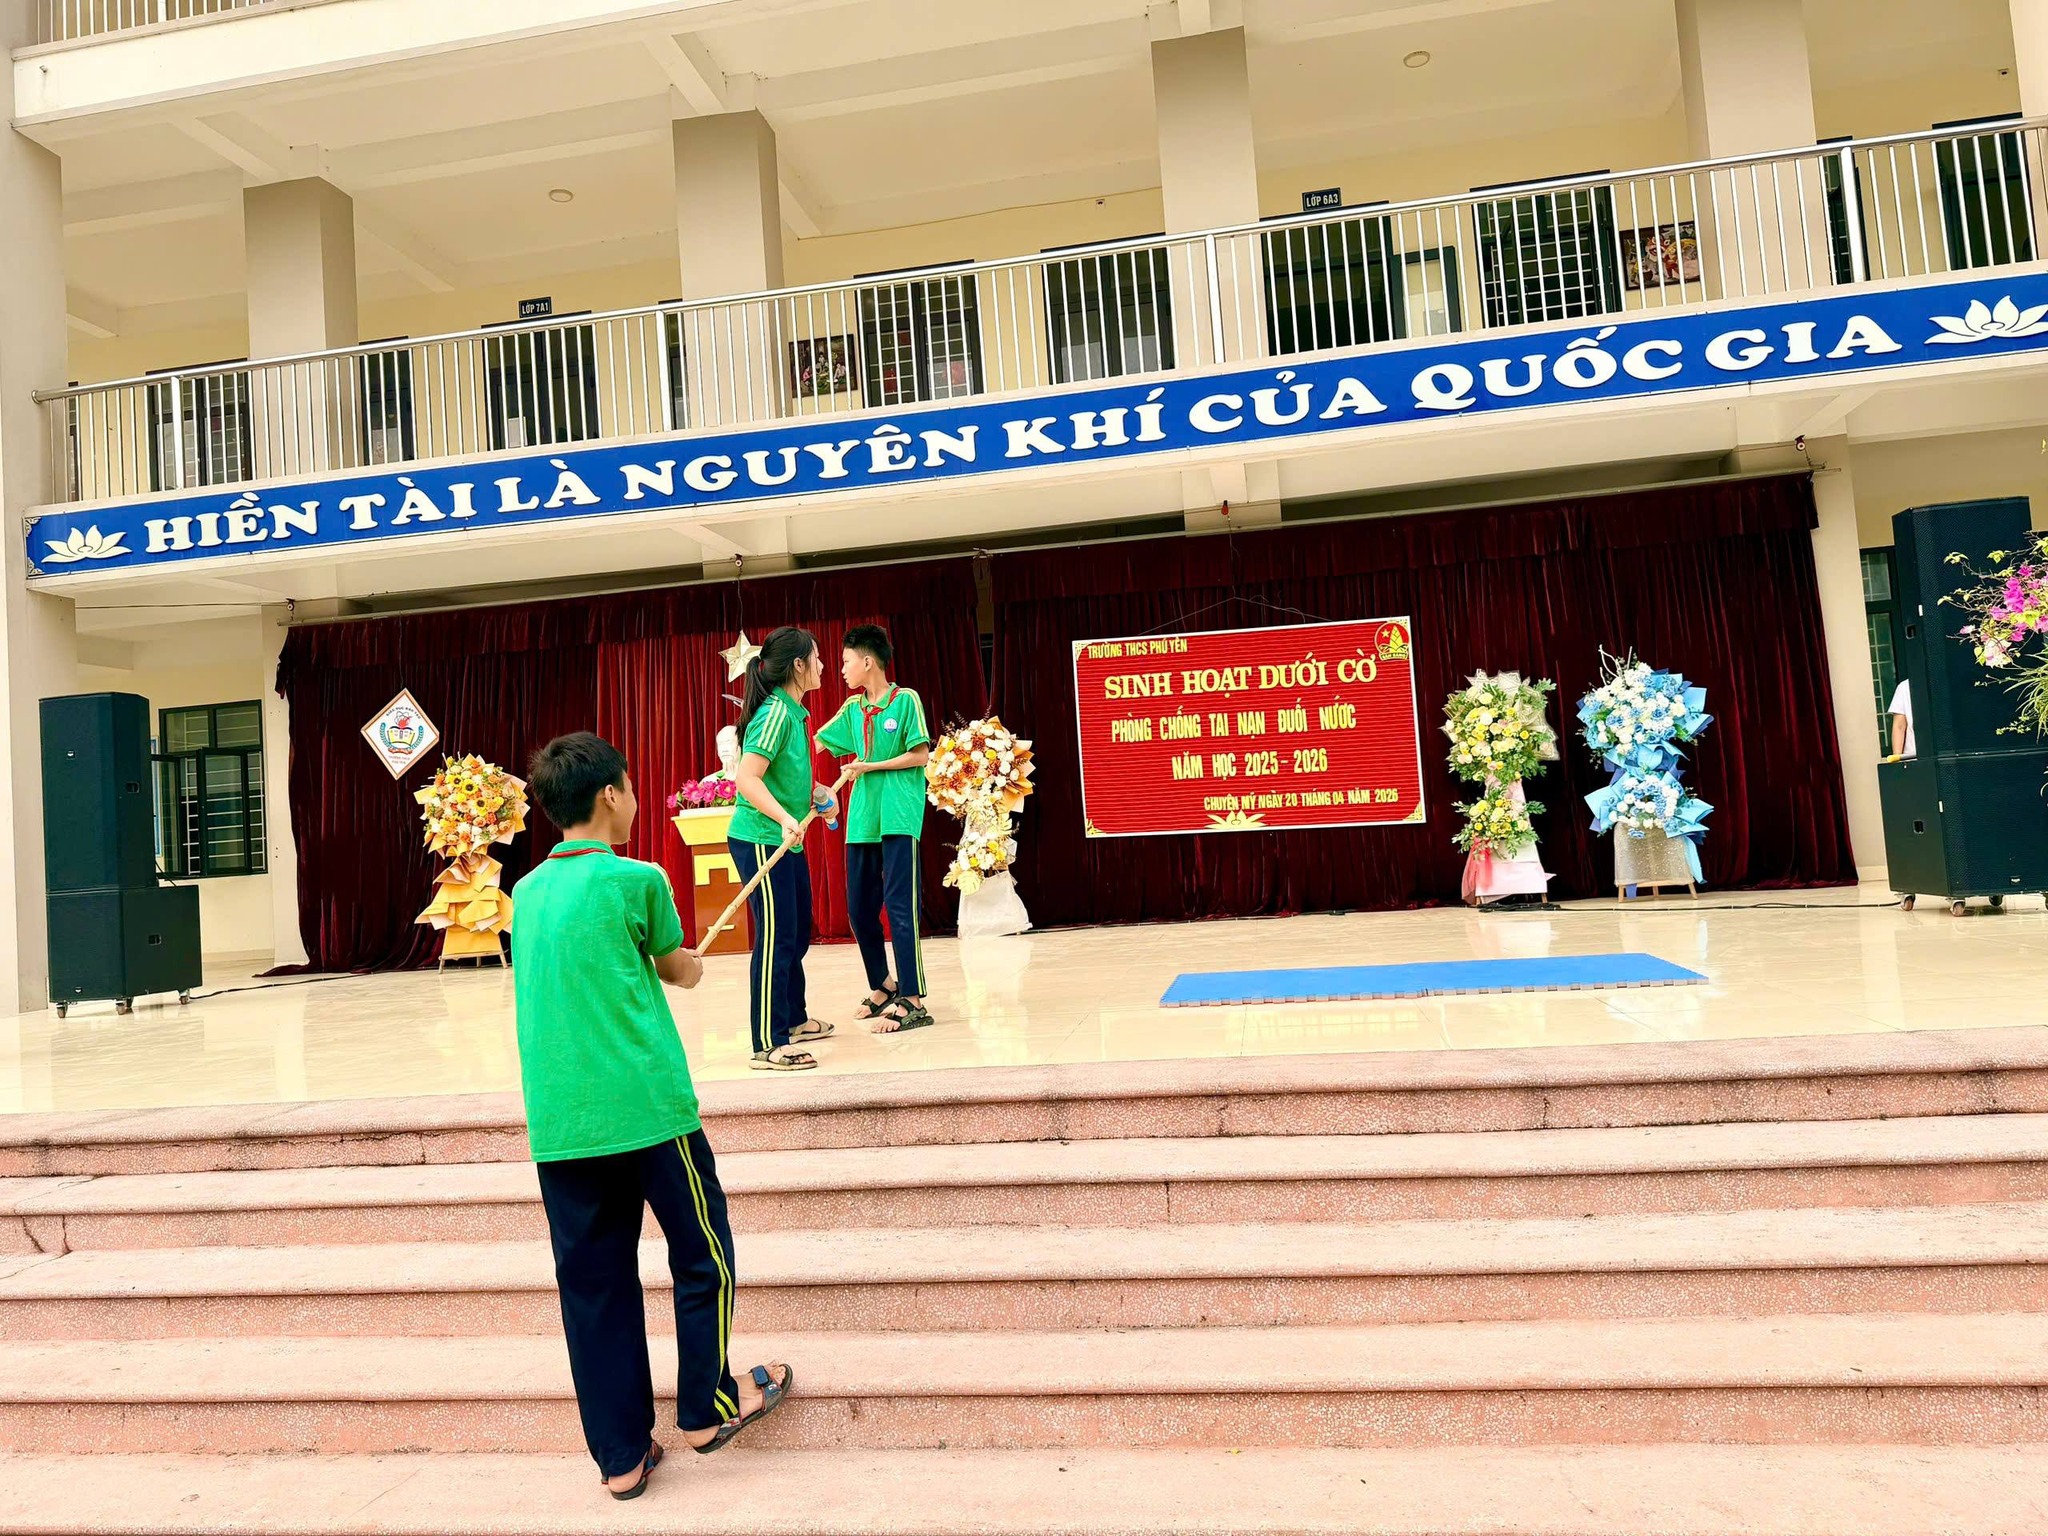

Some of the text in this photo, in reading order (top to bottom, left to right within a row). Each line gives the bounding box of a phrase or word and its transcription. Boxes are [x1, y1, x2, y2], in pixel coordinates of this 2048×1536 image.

[1306, 193, 1339, 207] LỚP 6A3
[521, 302, 549, 315] LỚP 7A1
[143, 315, 1904, 556] HIỀN TÀI LÀ NGUYÊN KHÍ CỦA QUỐC GIA
[1088, 641, 1122, 659] TRƯỜNG
[1125, 642, 1147, 656] THCS
[1169, 636, 1187, 653] YÊN
[1104, 648, 1378, 699] SINH HOẠT DƯỚI CỜ
[1111, 695, 1357, 743] PHÒNG CHỐNG TAI NẠN ĐUỐI NƯỚC
[1171, 751, 1204, 781] NĂM
[1211, 752, 1237, 781] HỌC
[1244, 750, 1279, 777] 2025
[1293, 747, 1328, 774] 2026
[1204, 793, 1239, 811] CHUYÊN
[1258, 789, 1283, 809] NGÀY
[1285, 792, 1298, 807] 20
[1301, 788, 1331, 807] THÁNG
[1332, 790, 1345, 806] 04
[1347, 787, 1371, 805] NĂM
[1374, 788, 1399, 803] 2026
